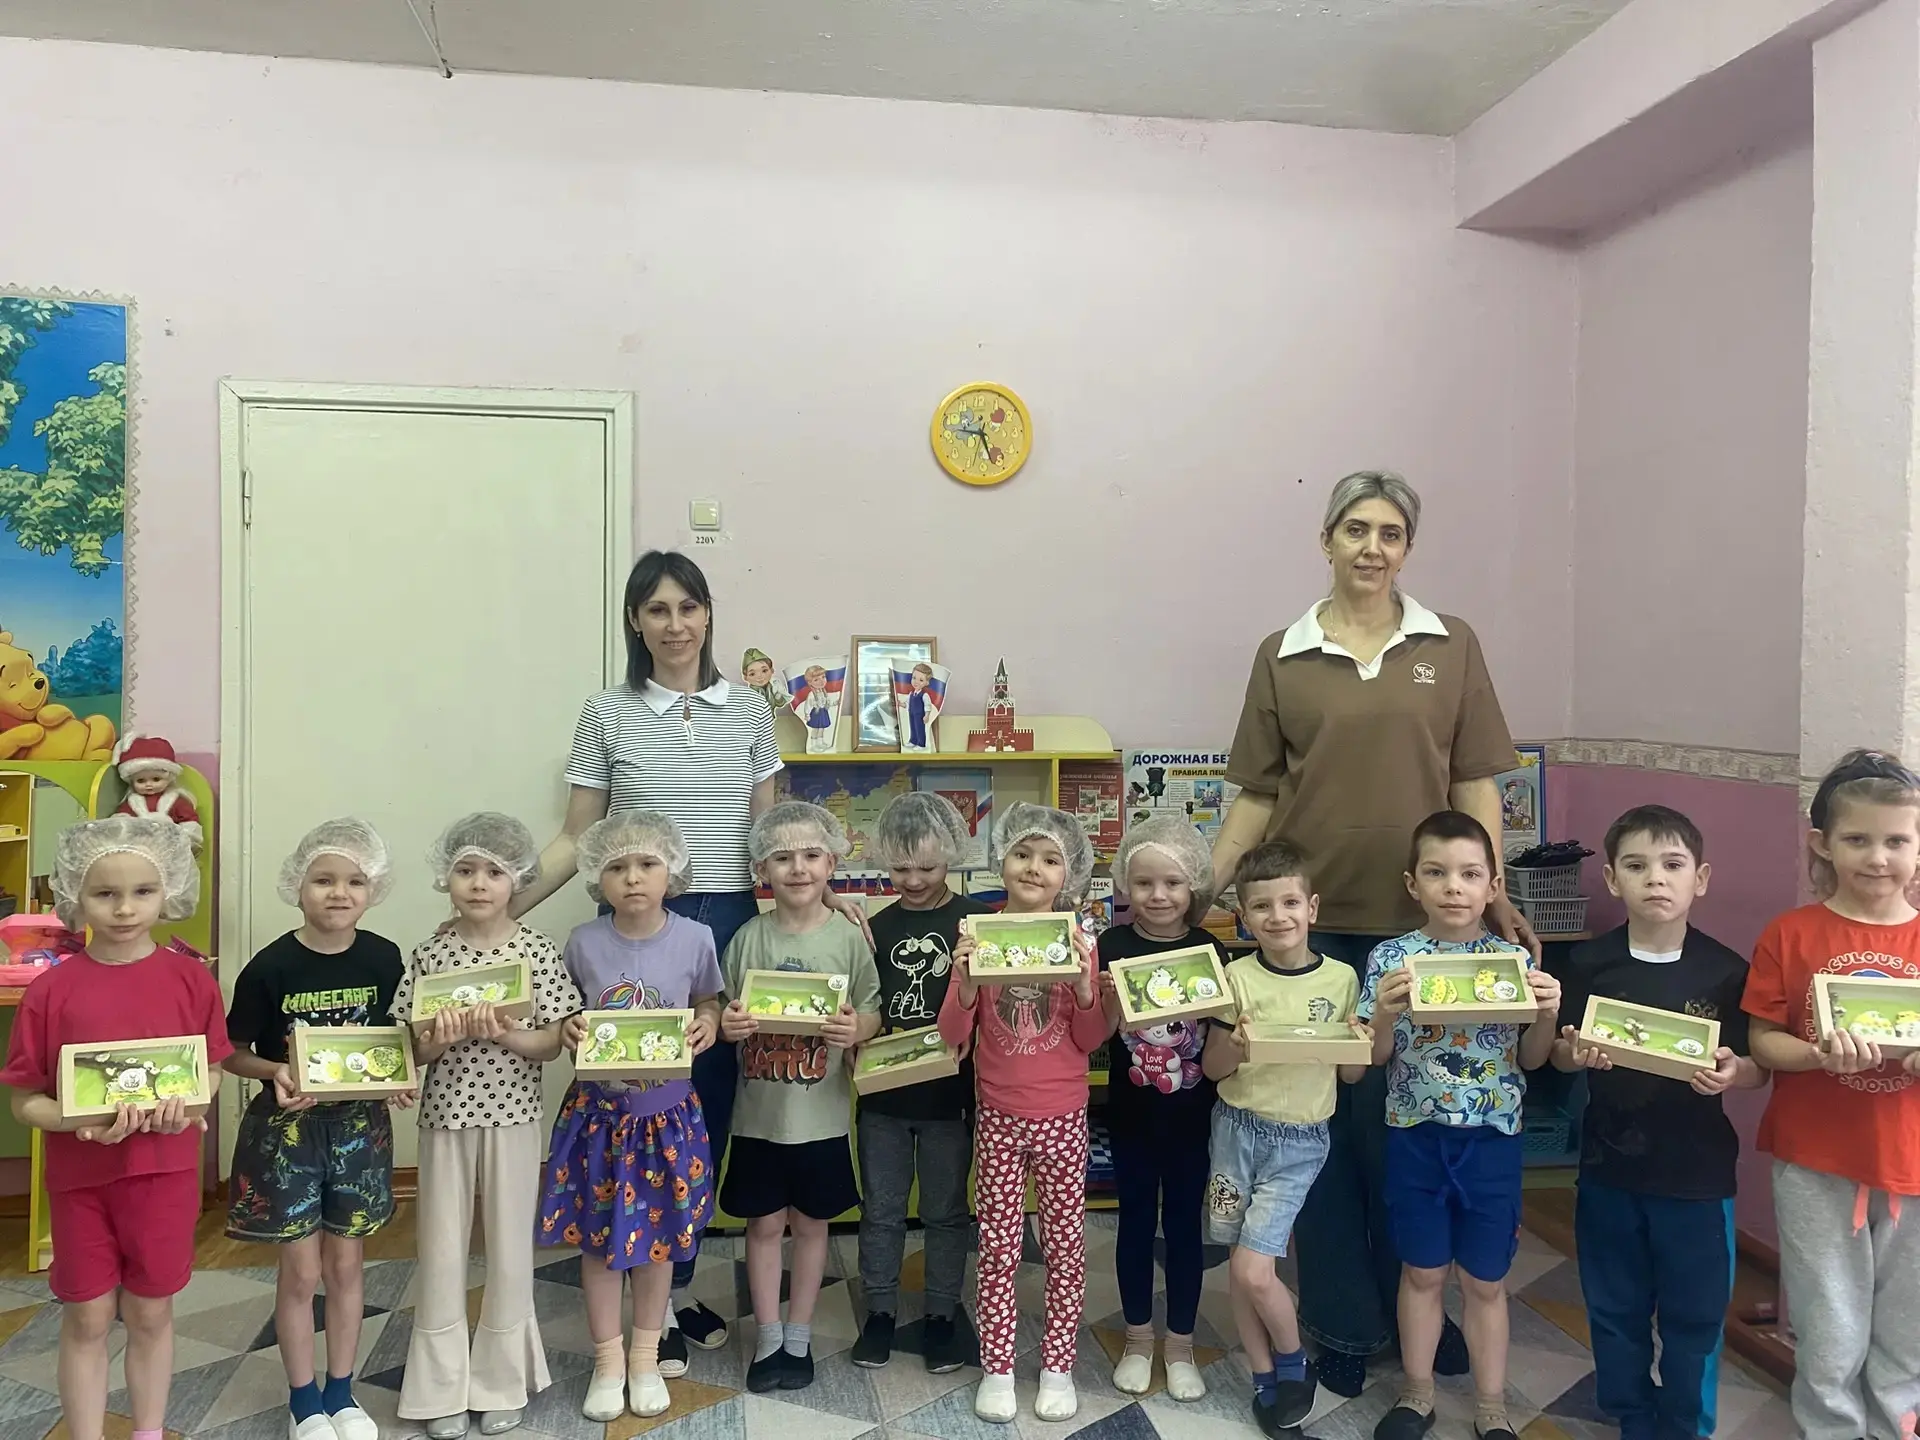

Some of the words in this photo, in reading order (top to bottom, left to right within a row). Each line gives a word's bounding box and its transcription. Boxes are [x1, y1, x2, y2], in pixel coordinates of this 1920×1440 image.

[695, 536, 716, 544] 220V
[1132, 754, 1209, 766] ДОРОЖНАЯ
[281, 986, 378, 1014] MINECRAFT
[1005, 1038, 1037, 1056] the
[743, 1046, 828, 1084] BATTLE
[1145, 1051, 1163, 1064] Love
